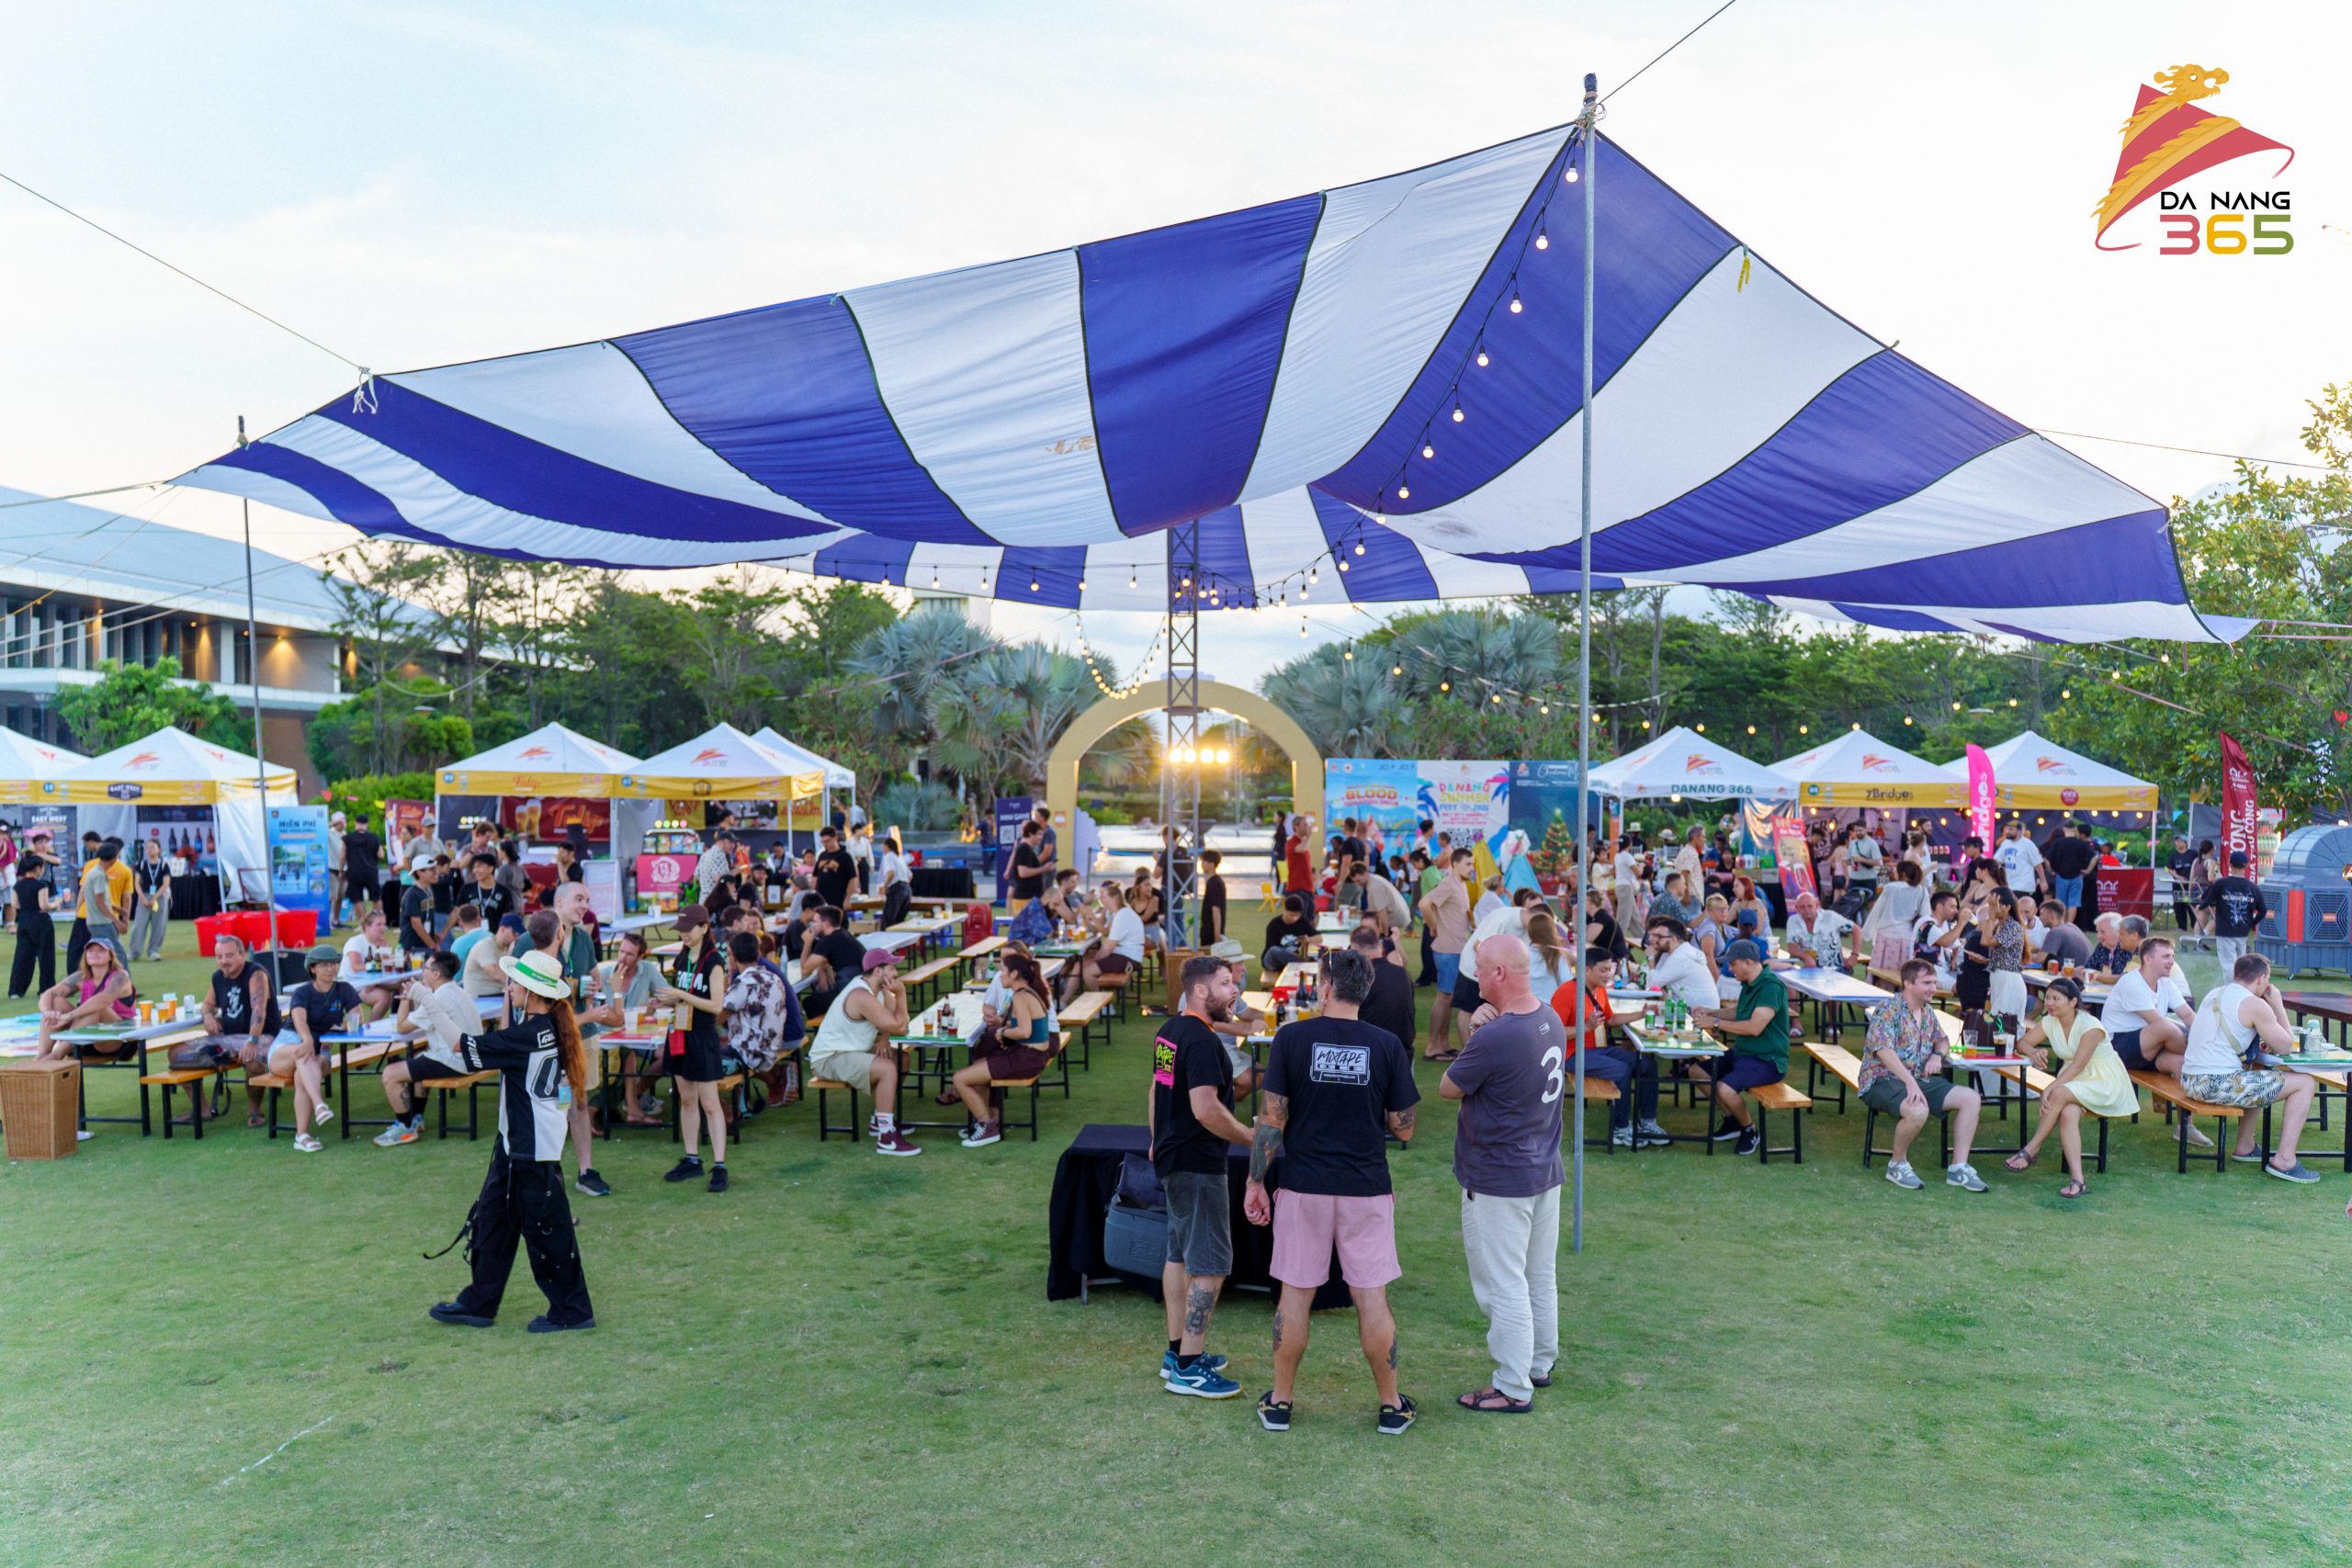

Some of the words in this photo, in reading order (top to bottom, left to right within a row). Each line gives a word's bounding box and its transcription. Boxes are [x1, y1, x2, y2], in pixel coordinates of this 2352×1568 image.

[1440, 782, 1490, 792] DANANG
[1671, 784, 1725, 794] DANANG
[1729, 784, 1753, 795] 365
[1346, 789, 1397, 800] BLOOD
[2243, 799, 2255, 833] CÔNG
[1317, 1048, 1364, 1066] MIXTAPE
[1541, 1045, 1563, 1104] 3
